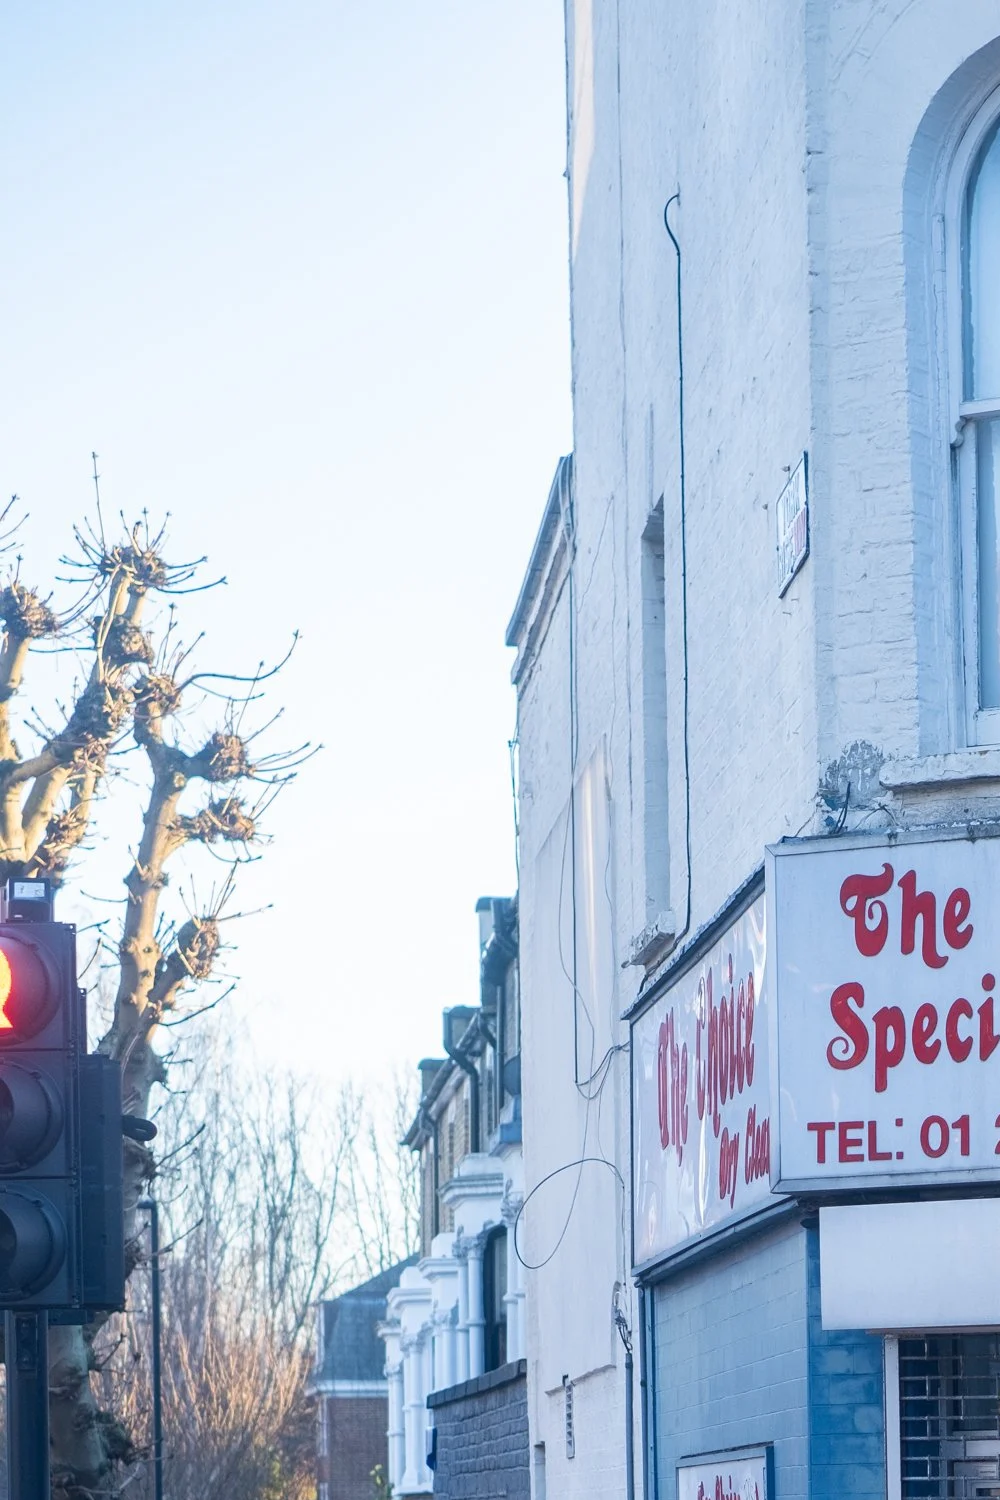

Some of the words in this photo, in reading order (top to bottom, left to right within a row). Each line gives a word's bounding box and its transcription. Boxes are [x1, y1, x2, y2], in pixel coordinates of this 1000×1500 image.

[838, 861, 974, 970] The
[657, 1006, 689, 1167] The
[695, 952, 755, 1139] Choice
[719, 1126, 740, 1209] Dry
[806, 1116, 905, 1164] TEL:
[919, 1113, 971, 1159] 01
